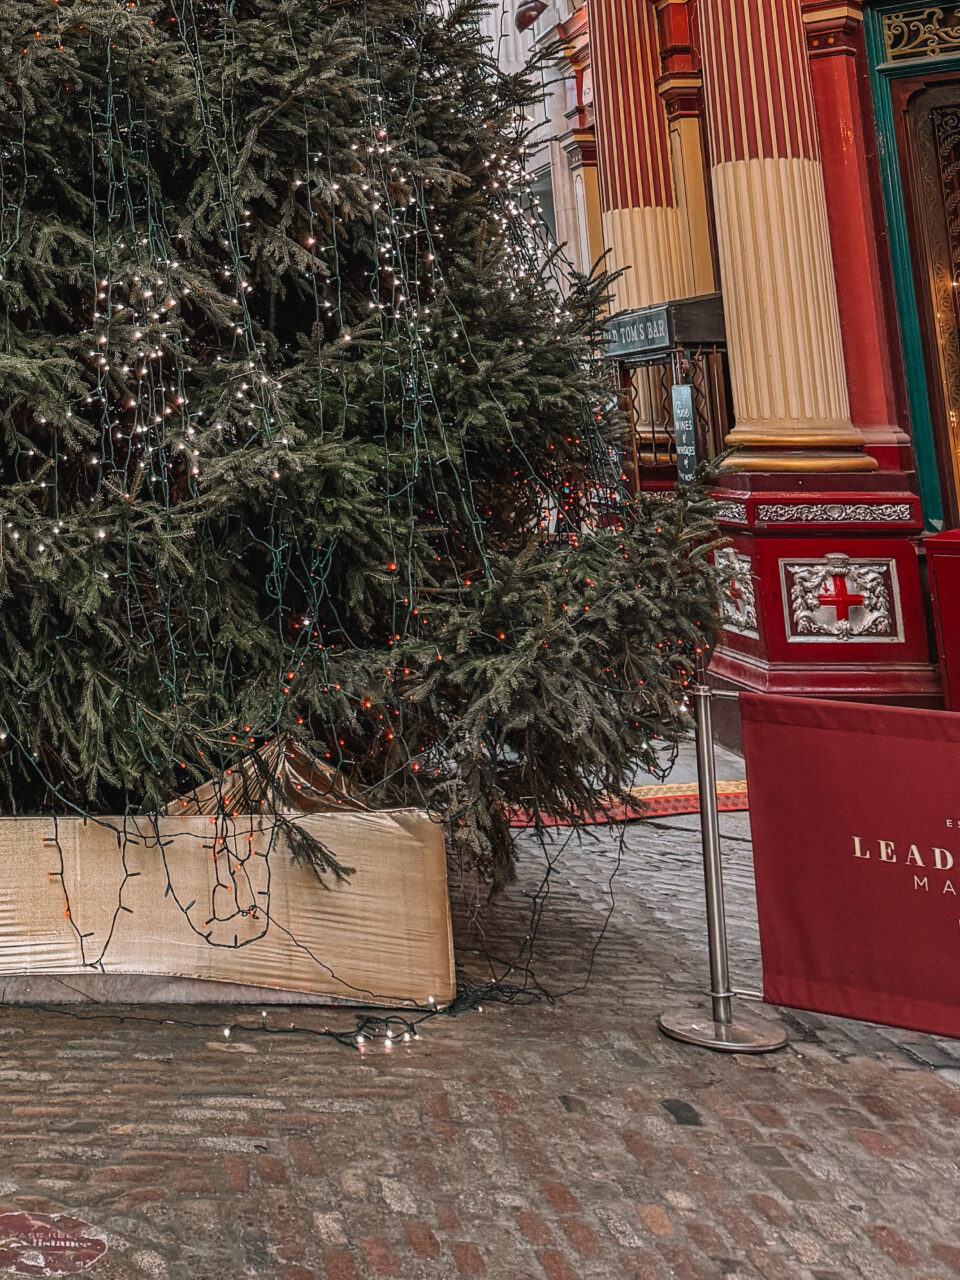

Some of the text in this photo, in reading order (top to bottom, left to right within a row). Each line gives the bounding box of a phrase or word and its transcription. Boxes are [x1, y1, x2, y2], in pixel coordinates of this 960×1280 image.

[620, 322, 645, 344] TOM'S
[647, 319, 665, 339] BAR
[675, 420, 693, 431] WINES
[851, 835, 954, 870] LEAD
[913, 874, 957, 896] MA
